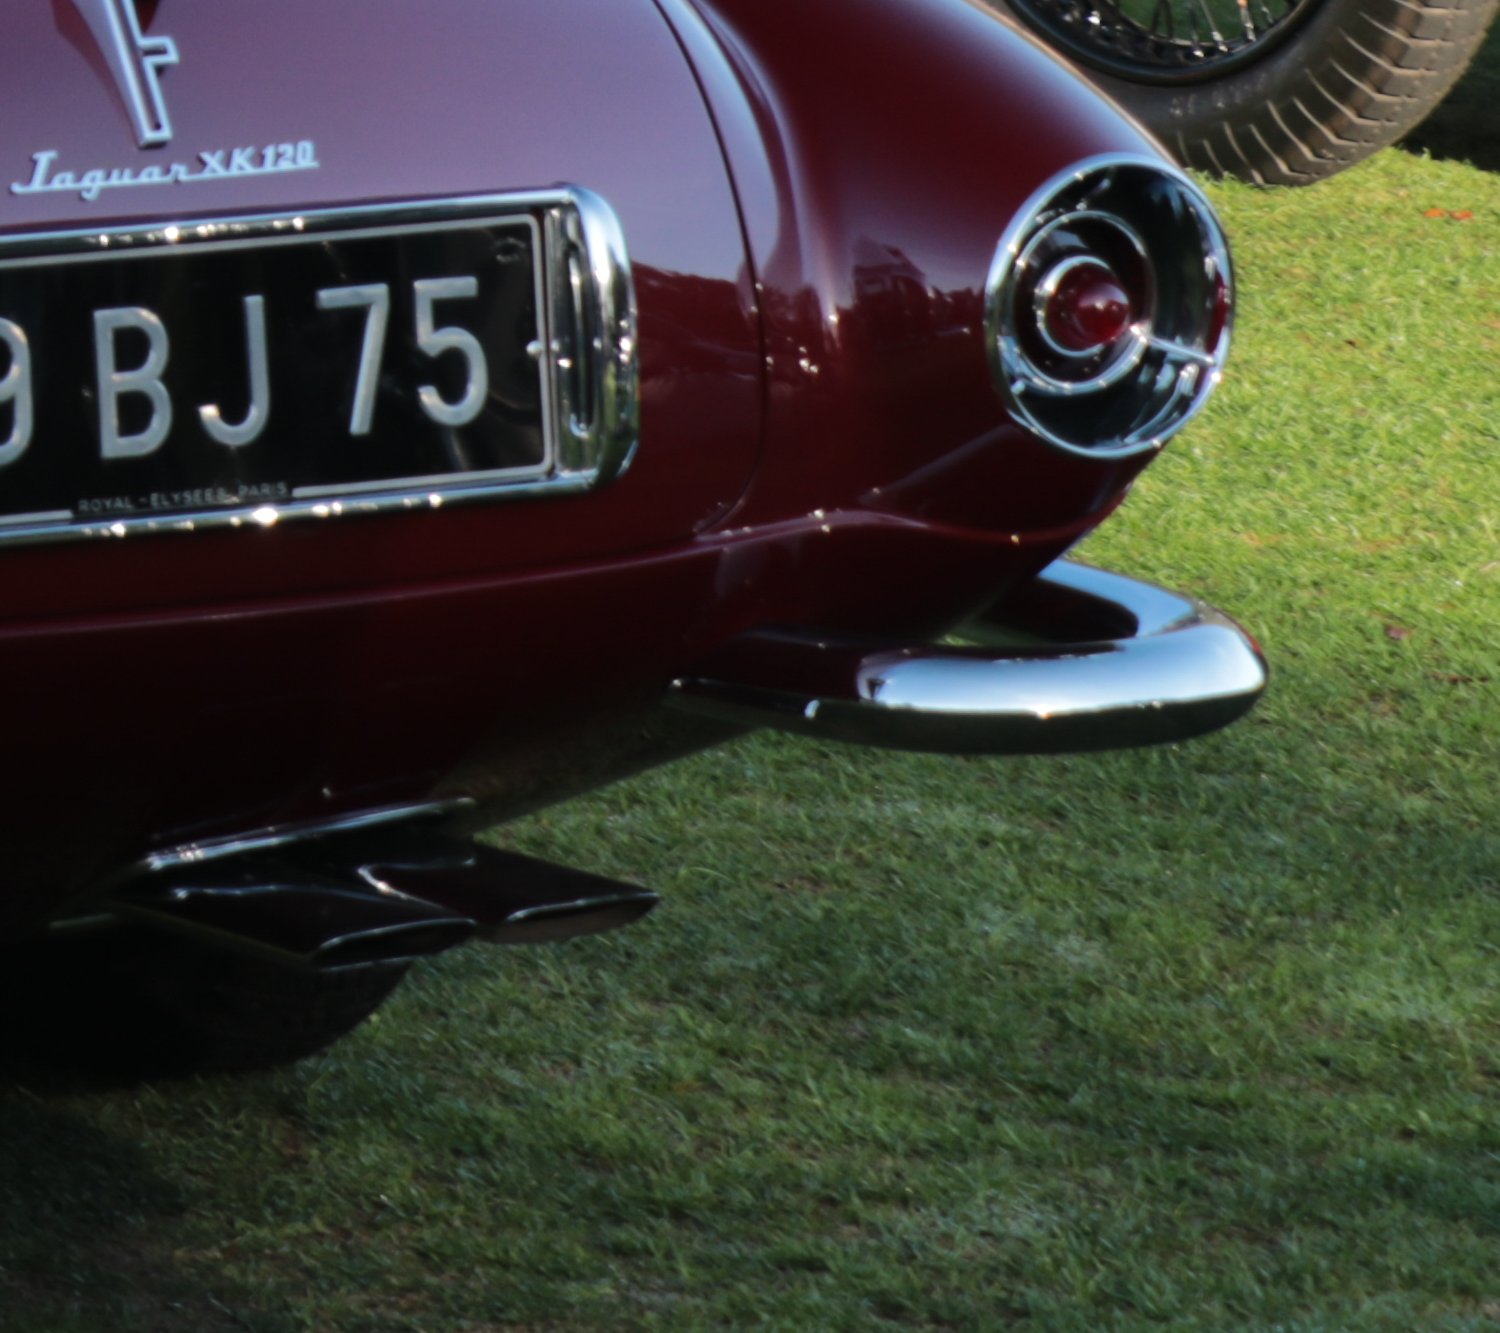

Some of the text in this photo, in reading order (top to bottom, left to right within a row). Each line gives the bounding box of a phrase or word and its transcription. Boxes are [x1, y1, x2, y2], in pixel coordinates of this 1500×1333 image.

[10, 149, 194, 201] Jaguar
[93, 293, 271, 459] BJ
[315, 275, 490, 436] 75
